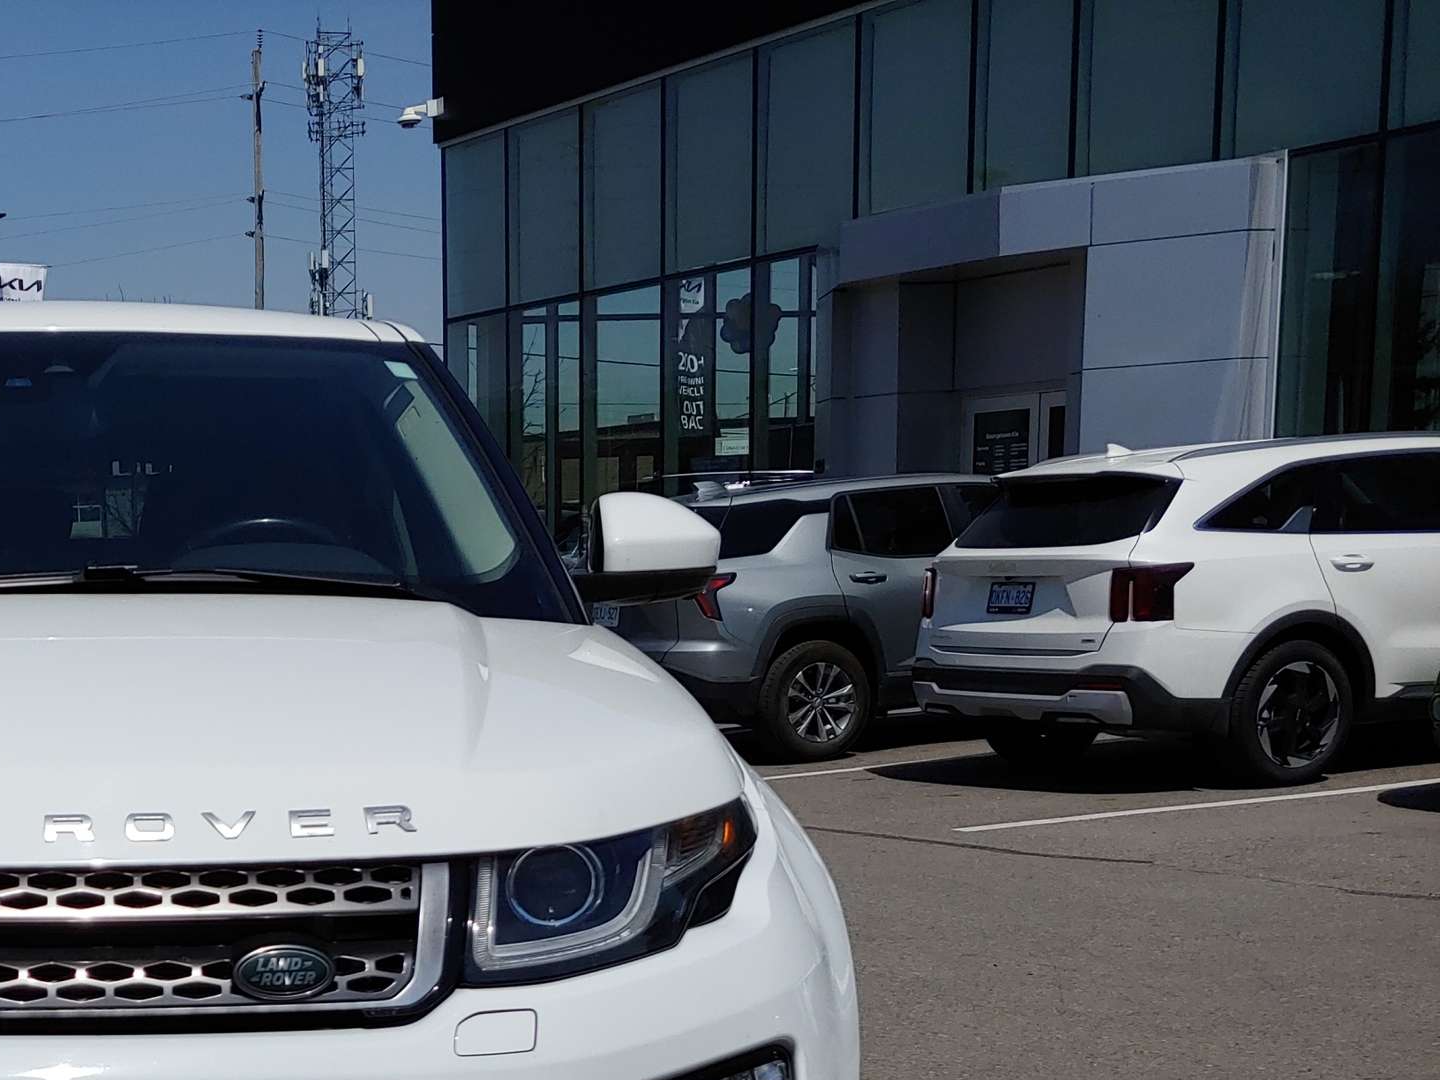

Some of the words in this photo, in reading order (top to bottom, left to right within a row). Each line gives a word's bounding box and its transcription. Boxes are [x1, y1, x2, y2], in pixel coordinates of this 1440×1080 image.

[43, 804, 418, 843] ROVER
[256, 957, 302, 972] LAND
[260, 971, 317, 986] ROVER
